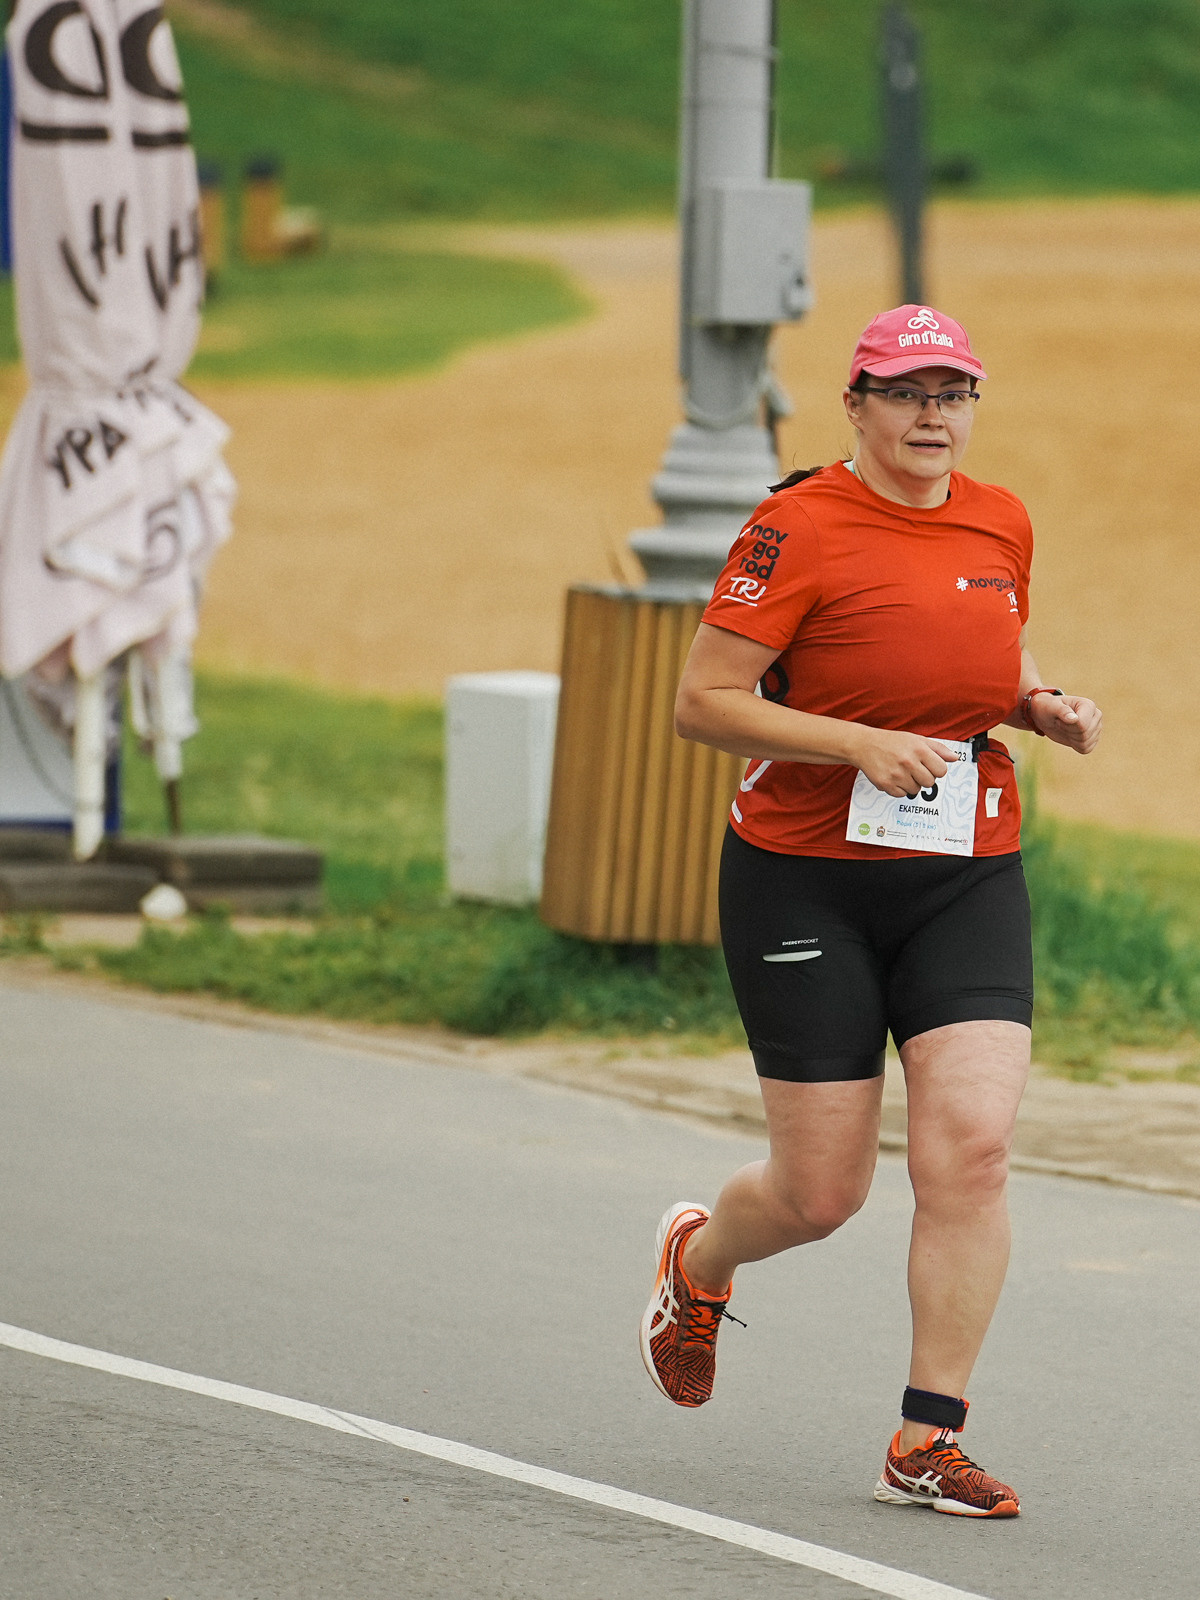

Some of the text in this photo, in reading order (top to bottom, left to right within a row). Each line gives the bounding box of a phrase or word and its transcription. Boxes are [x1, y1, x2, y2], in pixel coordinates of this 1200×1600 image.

[899, 331, 954, 348] Giro d'Italia
[750, 524, 789, 544] nov
[752, 540, 780, 560] go
[739, 556, 776, 580] rod
[899, 804, 939, 816] ЕКАТЕРИНА
